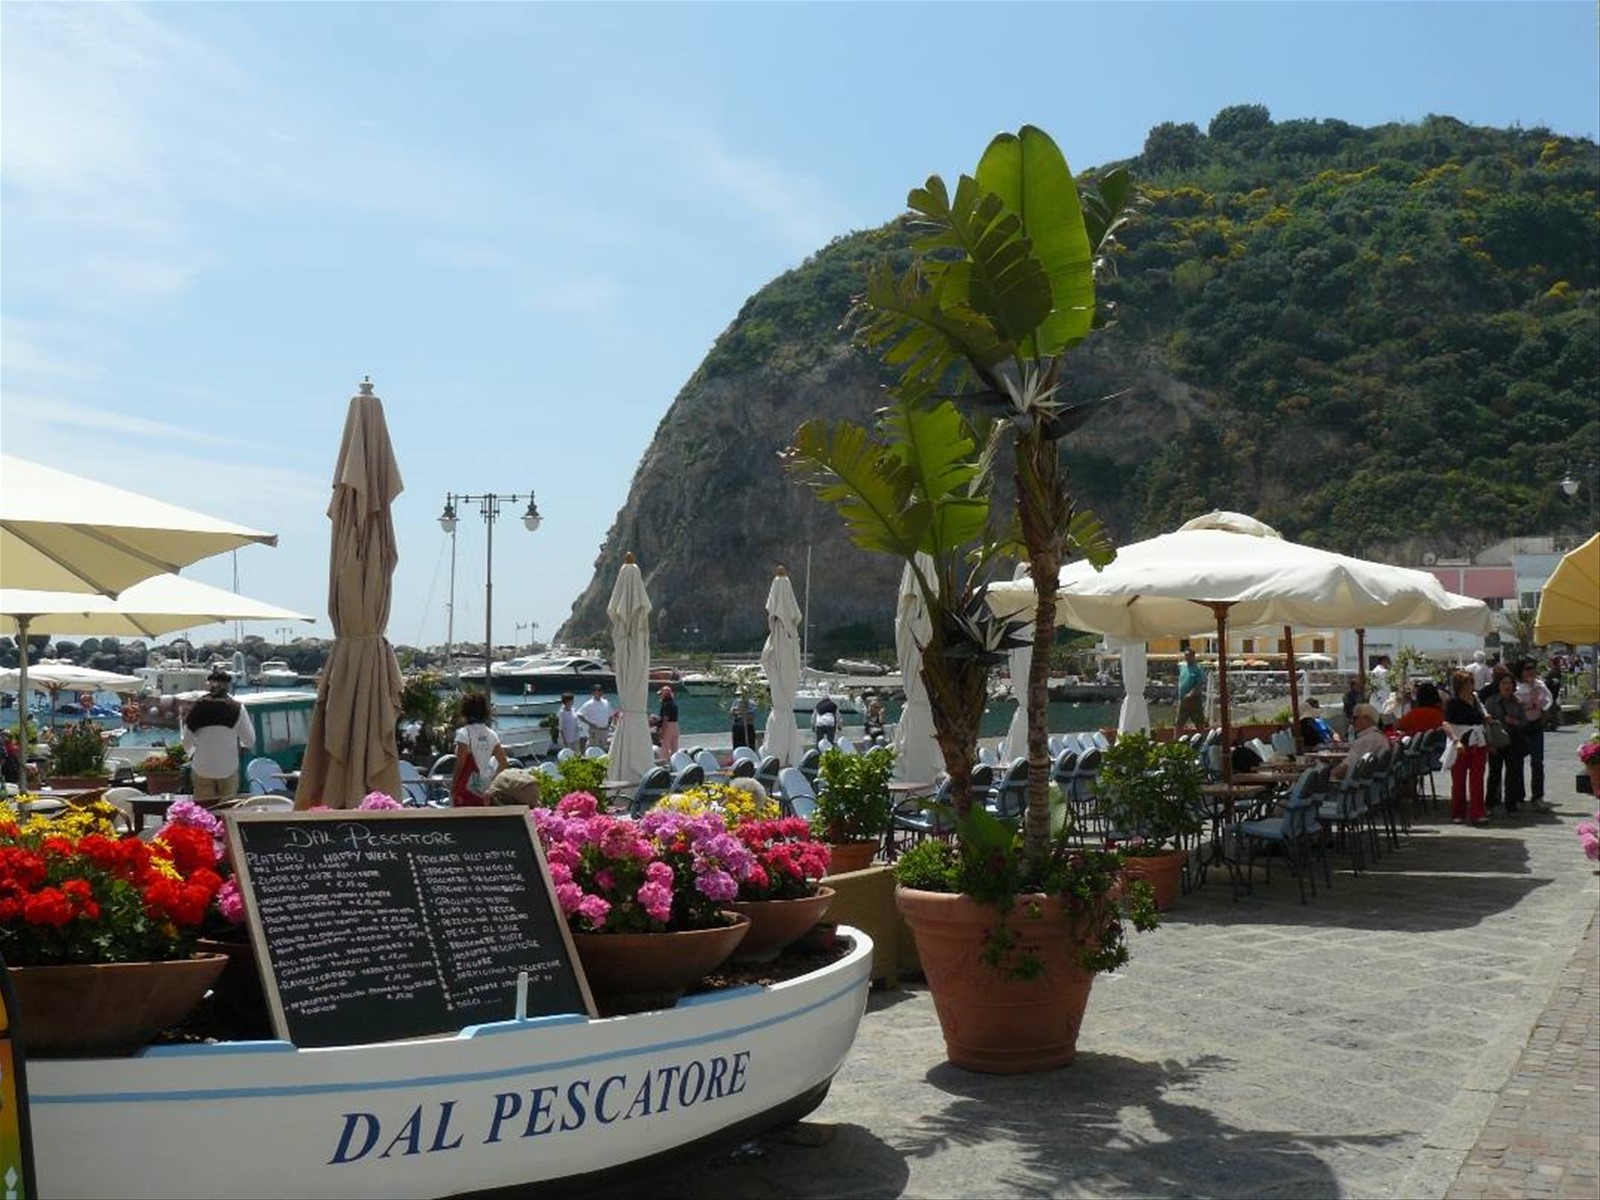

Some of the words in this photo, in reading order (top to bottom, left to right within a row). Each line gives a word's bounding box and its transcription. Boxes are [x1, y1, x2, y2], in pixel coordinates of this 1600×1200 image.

[283, 826, 335, 848] DAL
[336, 822, 456, 849] PESCATORE
[246, 851, 305, 866] PLATEAU
[323, 850, 361, 864] HAPPY
[365, 849, 399, 862] WEEK
[327, 1100, 464, 1165] DAL
[482, 1050, 751, 1144] PESCATORE
